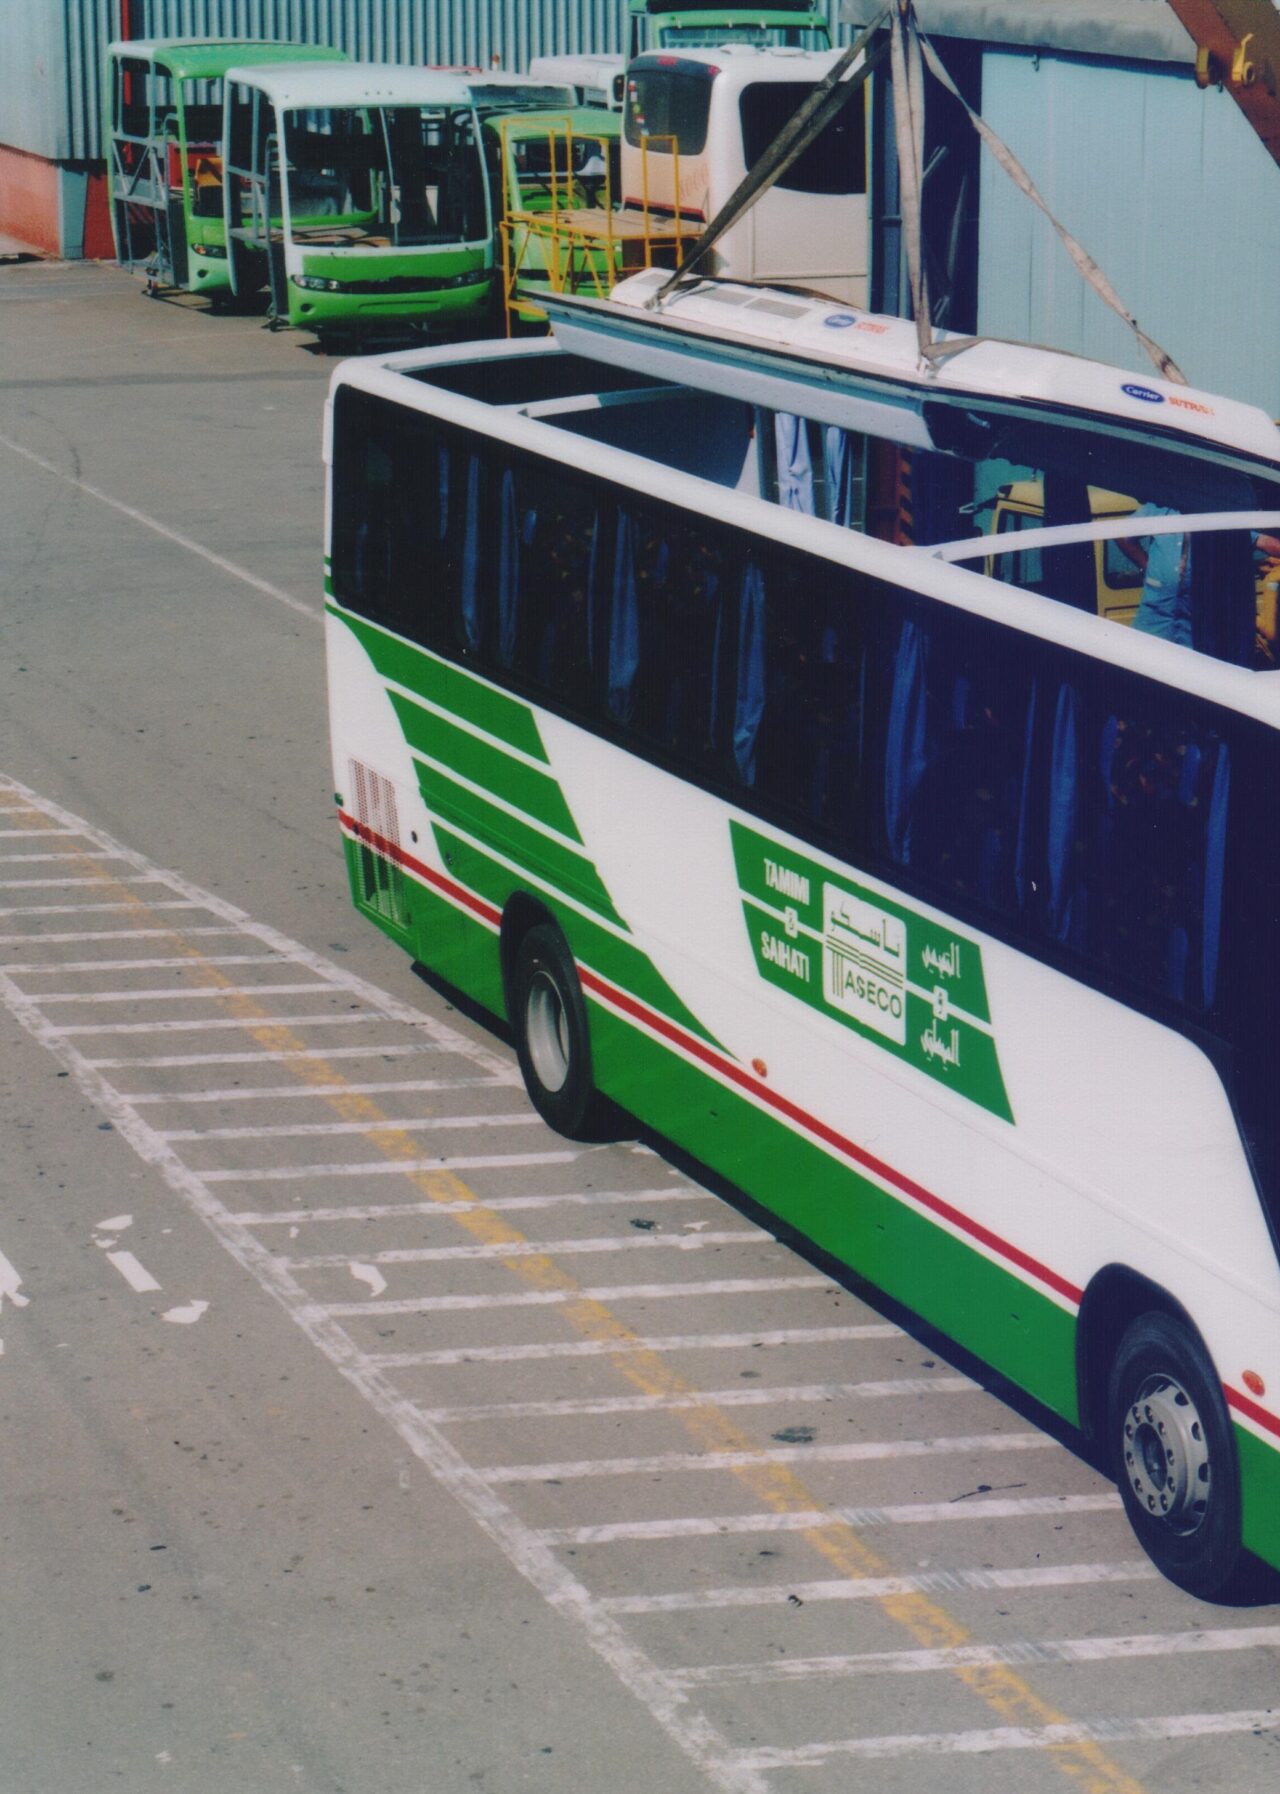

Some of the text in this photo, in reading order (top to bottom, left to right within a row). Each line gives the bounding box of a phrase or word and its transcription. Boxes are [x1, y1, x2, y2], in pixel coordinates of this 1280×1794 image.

[1125, 386, 1160, 401] Carrier
[763, 857, 810, 906] TAMIMI
[761, 930, 810, 983] SAIHATI
